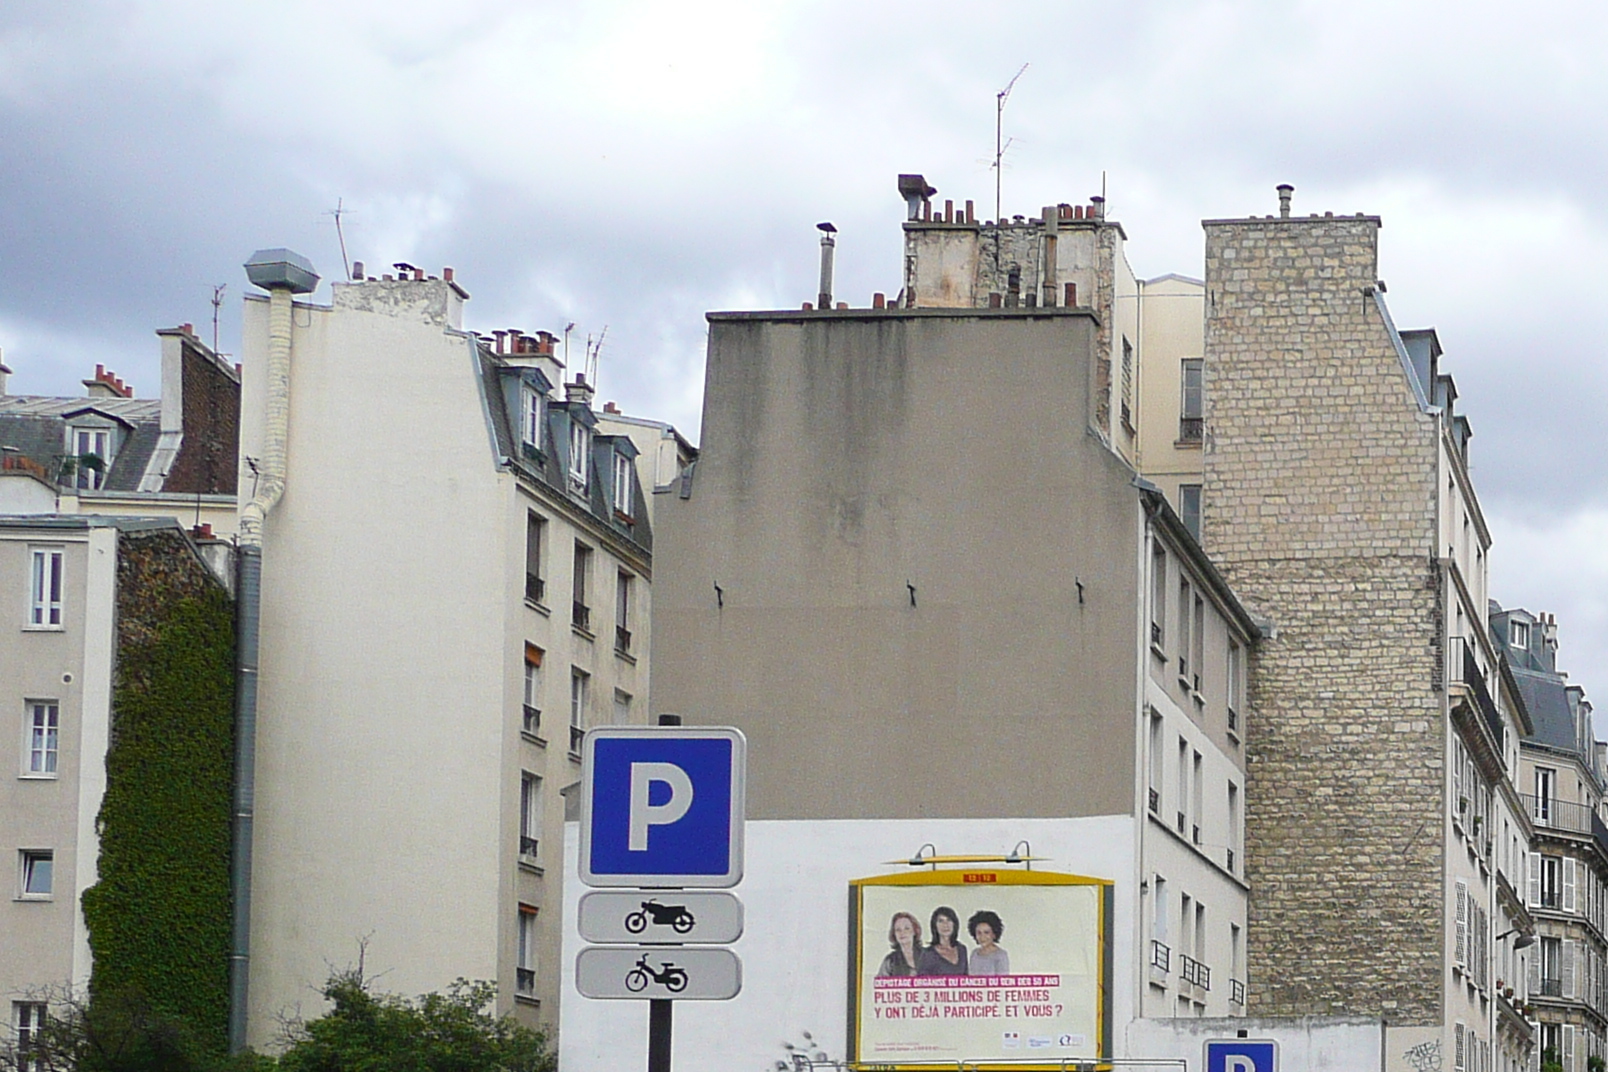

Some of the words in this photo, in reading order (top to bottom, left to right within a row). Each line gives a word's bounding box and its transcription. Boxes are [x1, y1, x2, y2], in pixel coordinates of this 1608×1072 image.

[629, 762, 693, 851] P
[874, 991, 901, 1003] PLUS
[905, 991, 919, 1003] DE
[923, 991, 930, 1003] 3
[934, 990, 983, 1003] MILLIONS
[987, 990, 1001, 1002] DE
[1005, 990, 1049, 1002] FEMMES
[874, 1007, 881, 1018] Y
[885, 1006, 906, 1018] ONT
[911, 1004, 939, 1018] DÉJÀ
[1005, 1005, 1018, 1018] ET
[1024, 1005, 1052, 1017] VOUS
